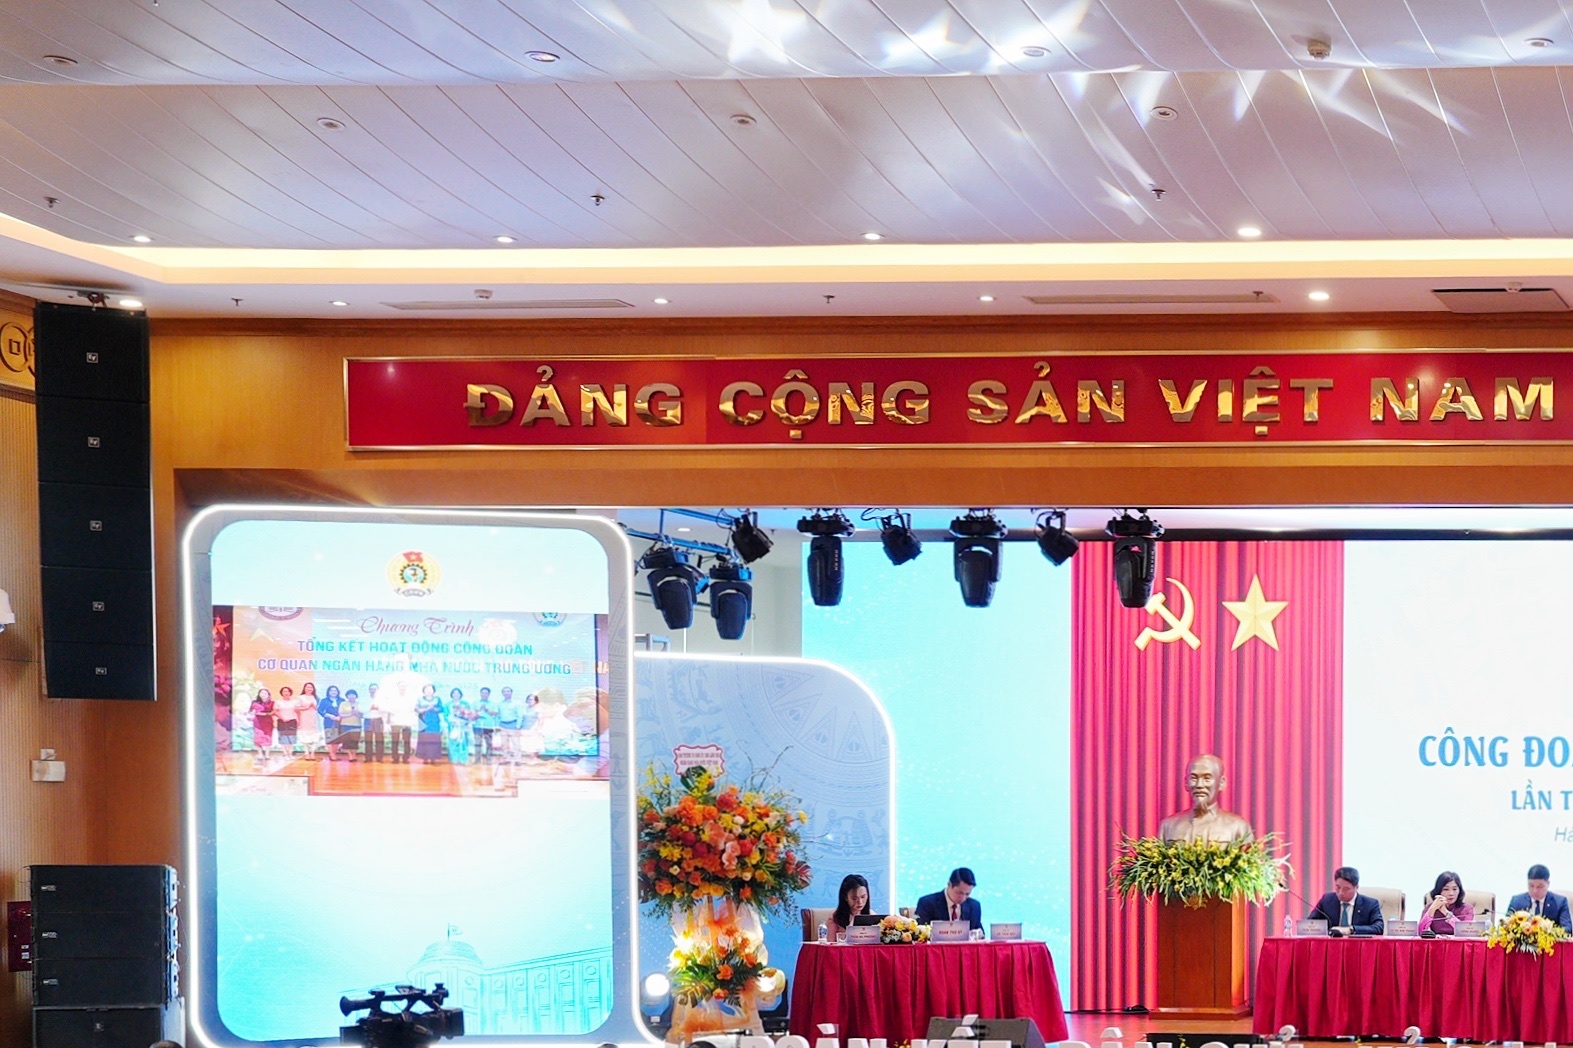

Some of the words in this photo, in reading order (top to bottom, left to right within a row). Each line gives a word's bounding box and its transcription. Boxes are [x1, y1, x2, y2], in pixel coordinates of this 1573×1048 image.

[463, 364, 684, 428] ĐẢNG
[718, 368, 930, 439] CỘNG
[966, 360, 1126, 424] SẢN
[1158, 365, 1334, 435] VIỆT
[1369, 376, 1555, 423] NAM
[1418, 726, 1509, 767] CÔNG
[1511, 779, 1552, 811] LẦN
